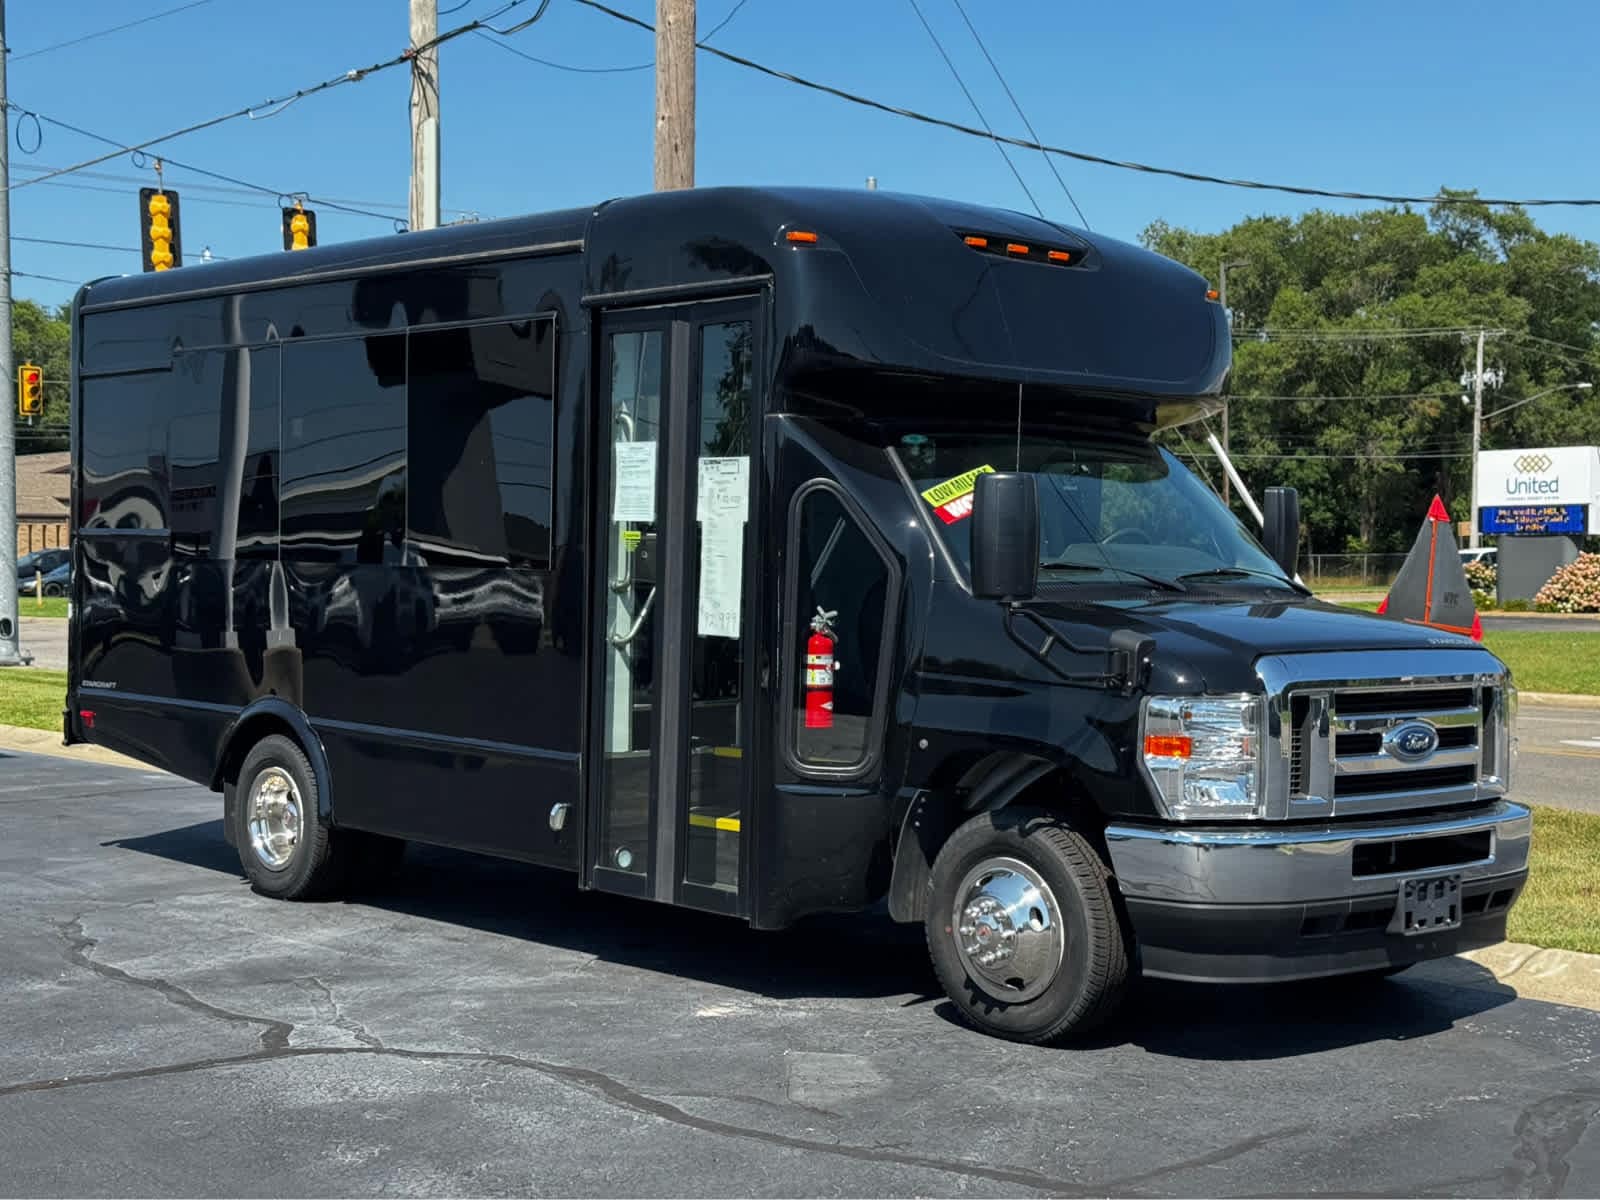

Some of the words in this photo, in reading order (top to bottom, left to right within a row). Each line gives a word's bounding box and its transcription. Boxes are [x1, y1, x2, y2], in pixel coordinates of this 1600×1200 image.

[928, 484, 953, 502] LOW
[1506, 476, 1559, 495] United
[1406, 733, 1430, 750] Ford
